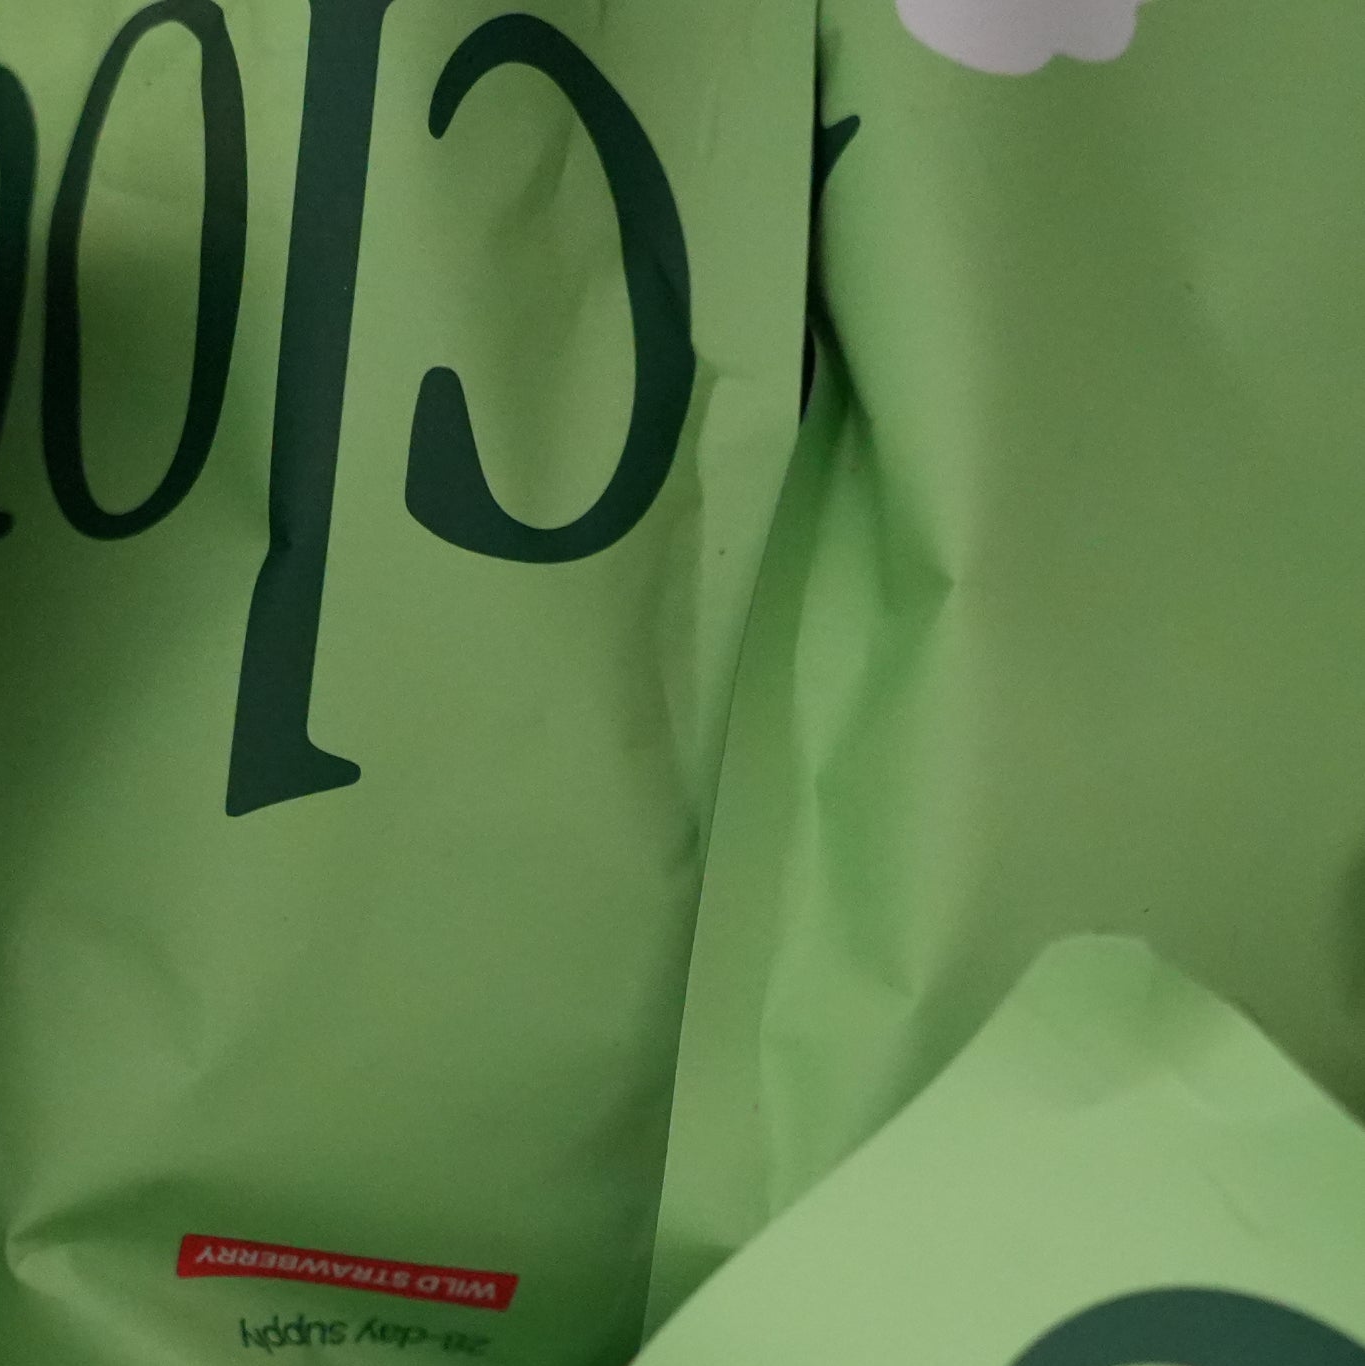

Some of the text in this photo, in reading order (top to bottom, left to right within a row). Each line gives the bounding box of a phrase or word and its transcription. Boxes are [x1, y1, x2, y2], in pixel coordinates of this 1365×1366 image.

[194, 1244, 497, 1302] WILD STRAWBERRY
[239, 1314, 347, 1356] supply
